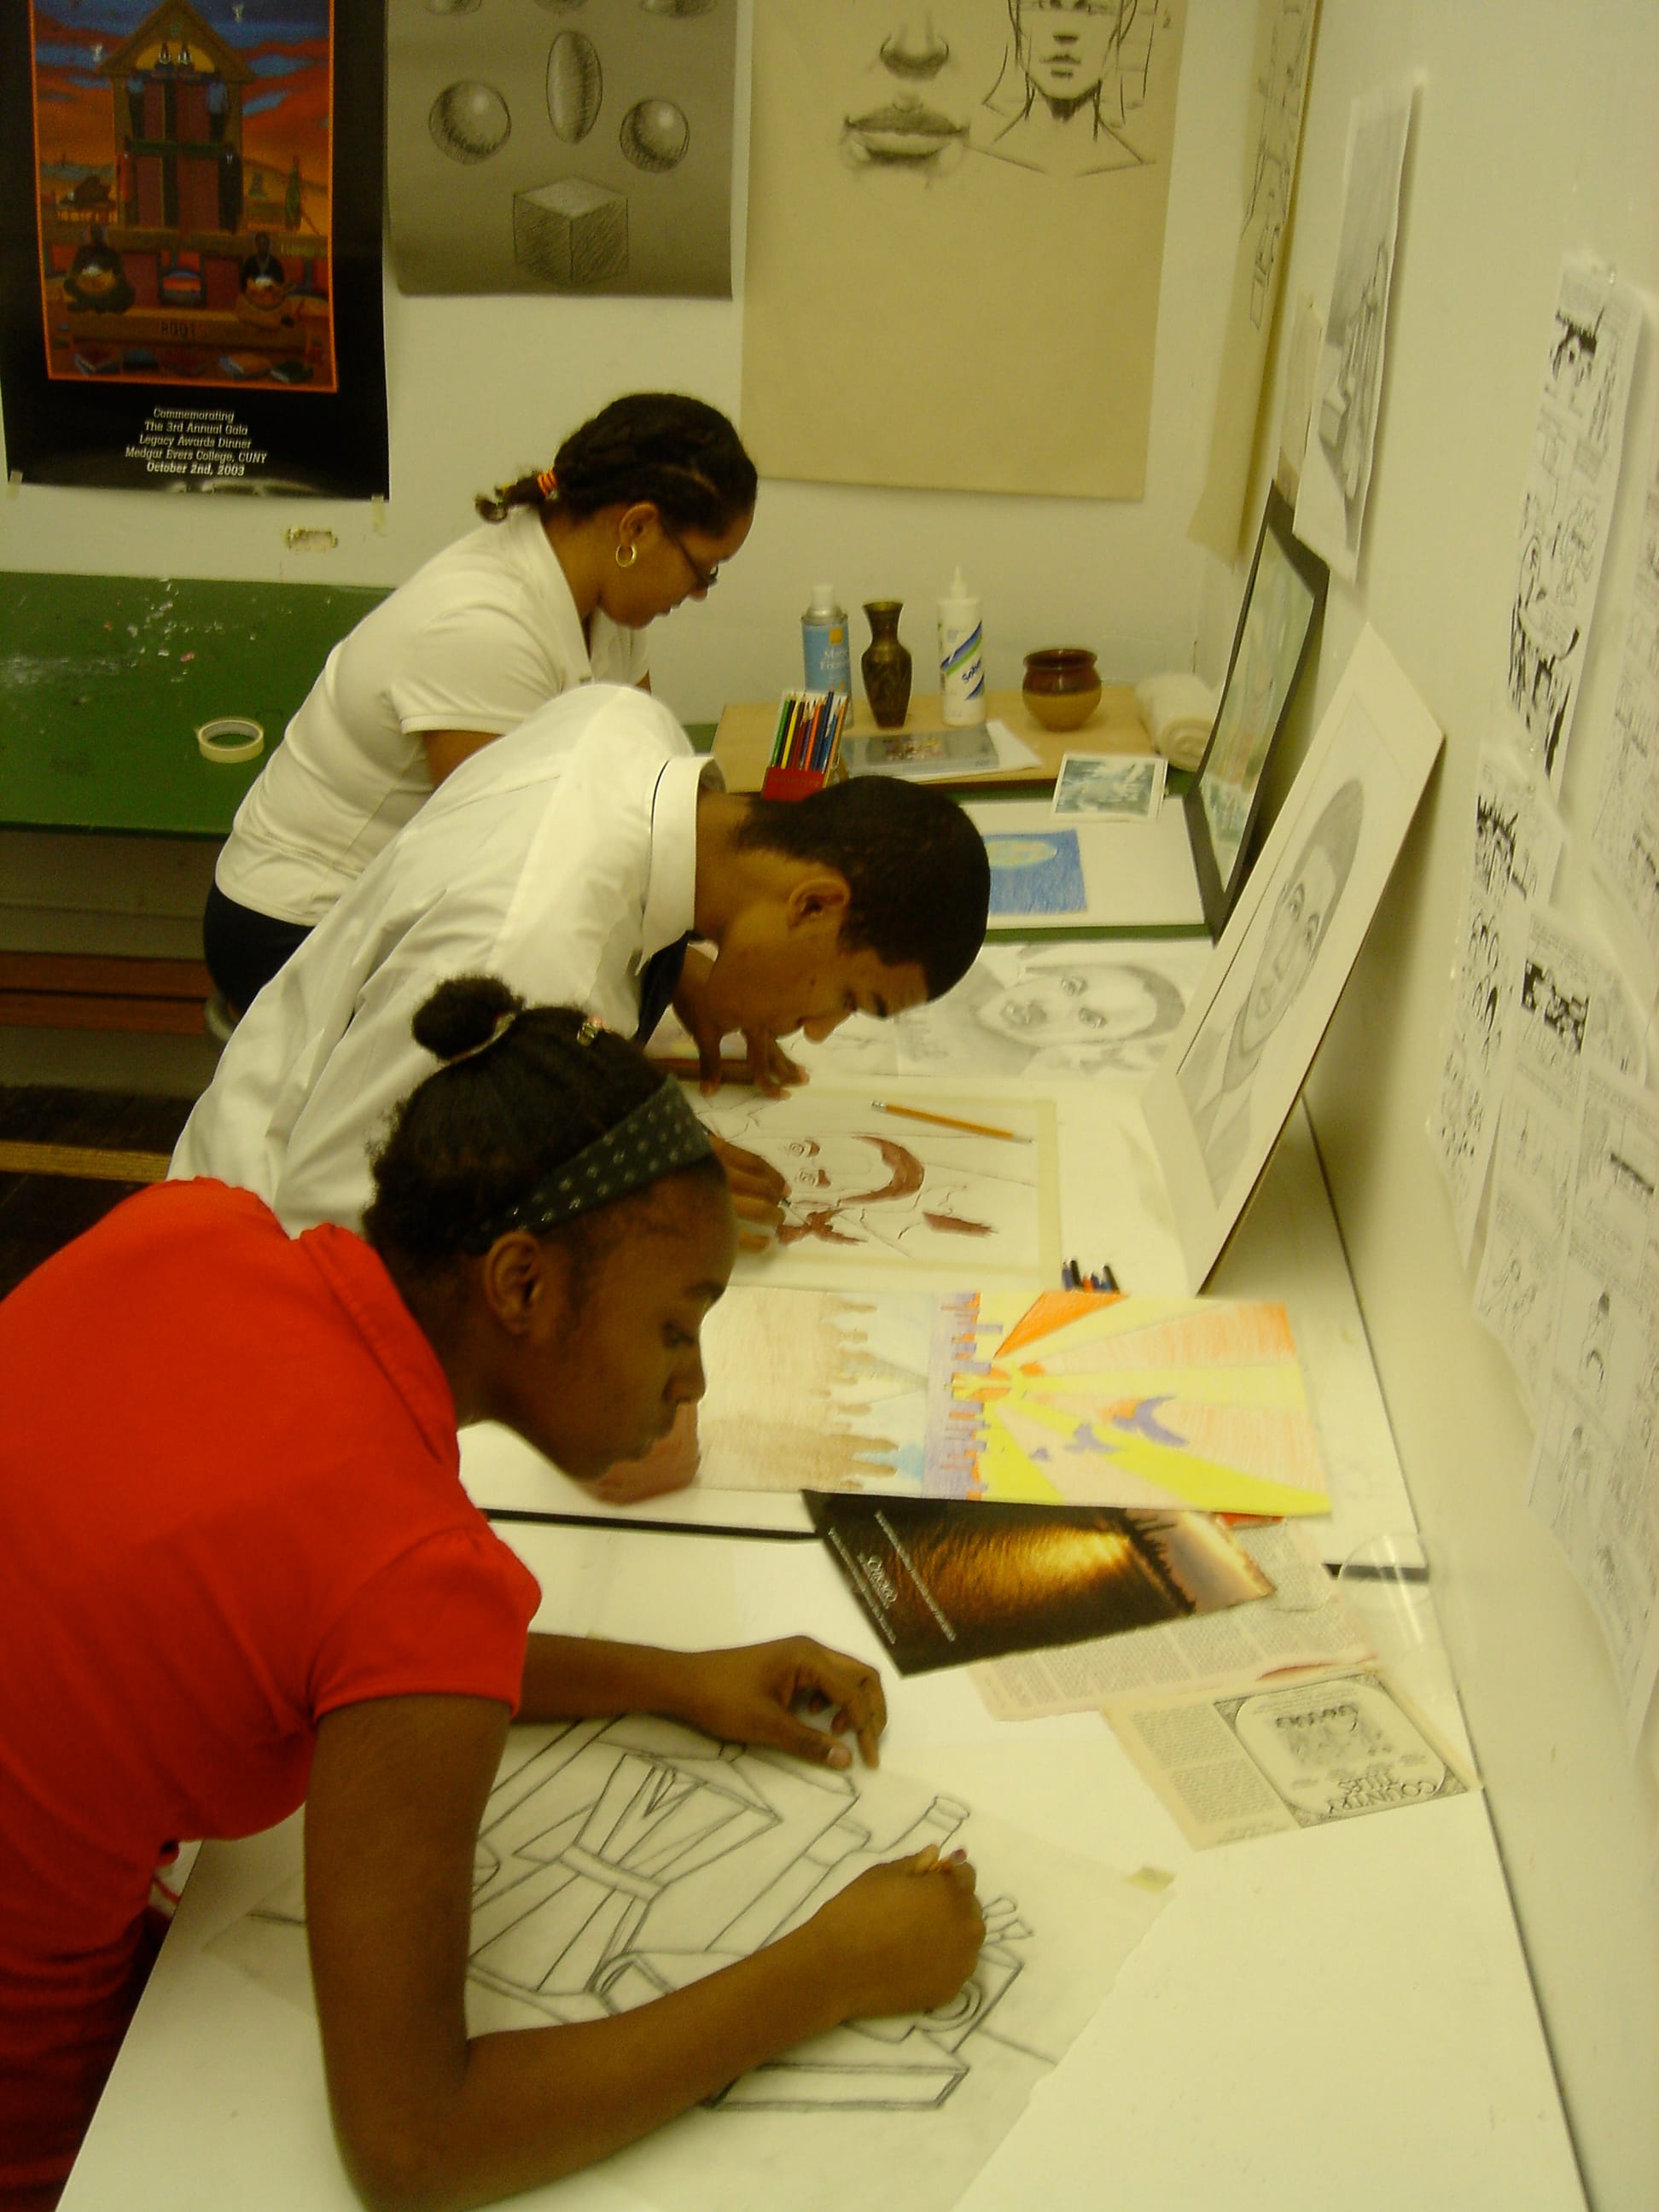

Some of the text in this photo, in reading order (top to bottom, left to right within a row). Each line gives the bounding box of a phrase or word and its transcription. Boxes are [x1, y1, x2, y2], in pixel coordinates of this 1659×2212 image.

[154, 408, 235, 424] Commemorating
[144, 421, 248, 435] The 3rd Annual Gala
[139, 434, 253, 450] Legacy Awards Dinner
[125, 445, 268, 465] Medgar Evers College, CUNY
[147, 462, 246, 477] October 2nd, 2003
[1327, 1779, 1437, 1814] COUNTRY
